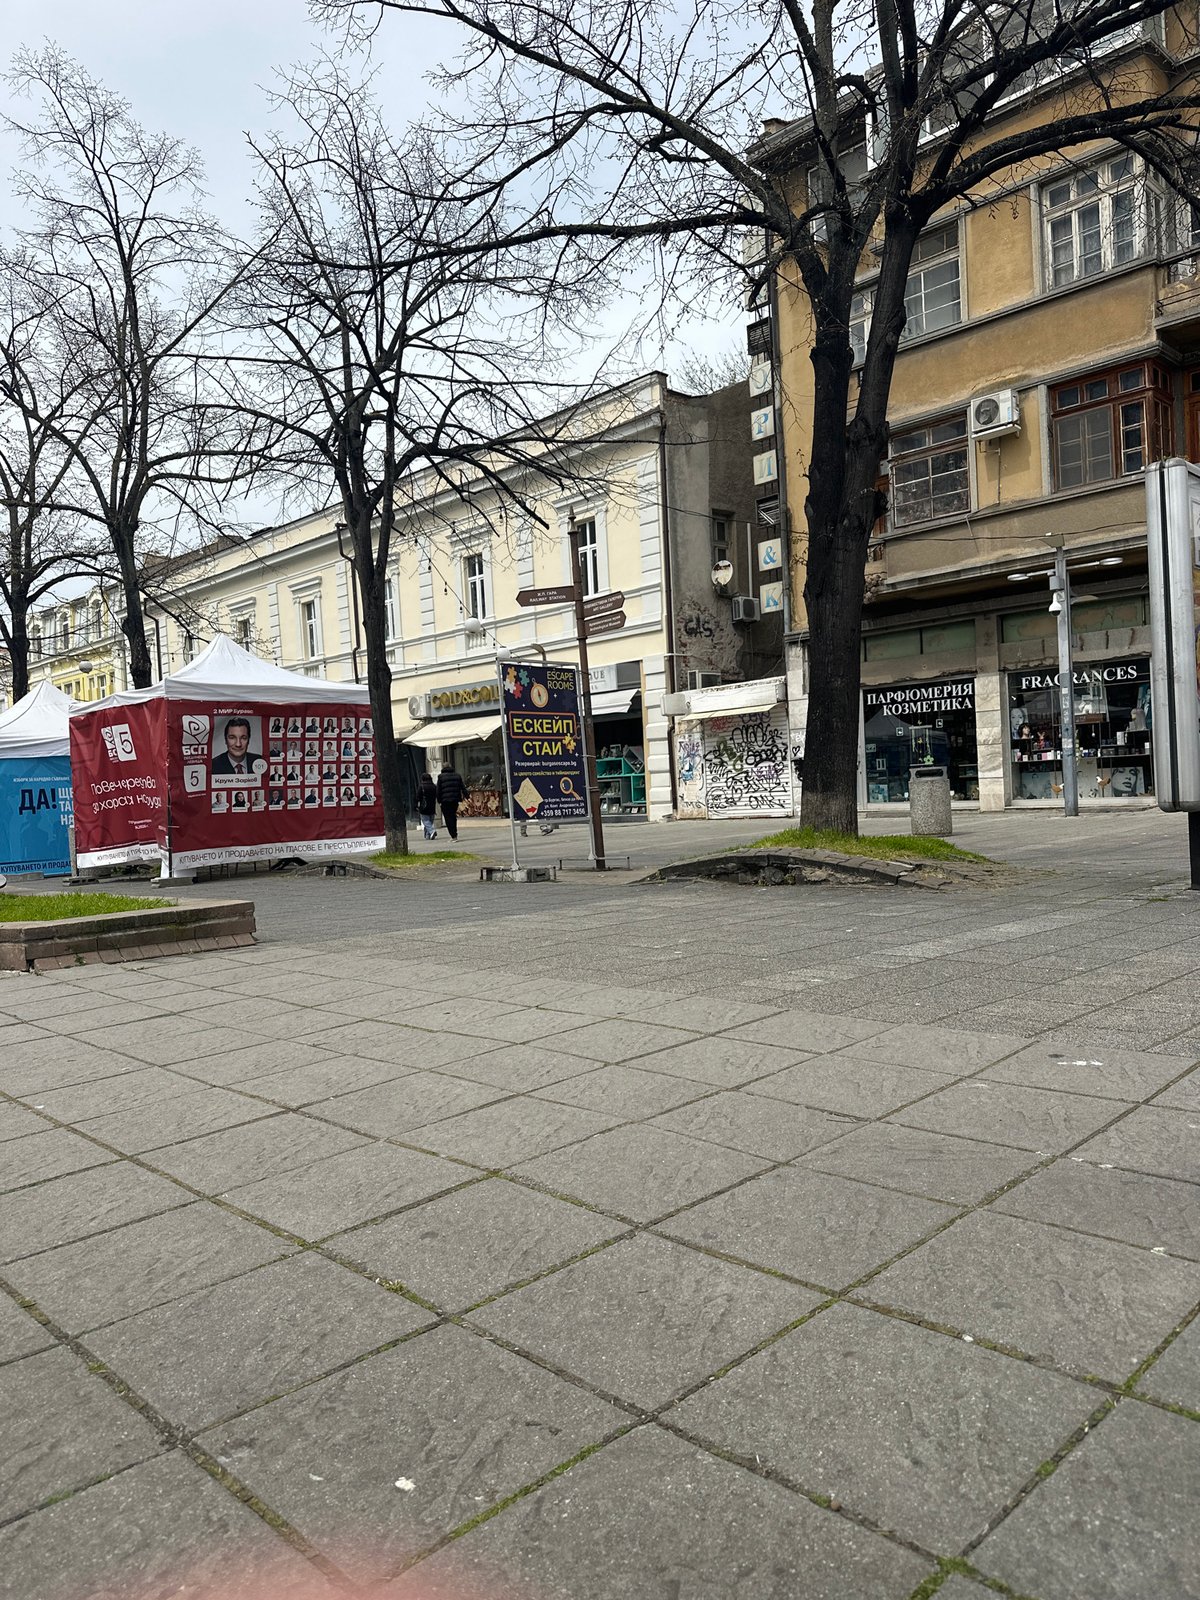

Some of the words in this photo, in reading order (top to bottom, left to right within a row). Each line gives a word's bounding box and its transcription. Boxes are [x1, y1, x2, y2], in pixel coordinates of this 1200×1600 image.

[547, 671, 574, 680] ESCAPE
[547, 681, 575, 691] ROOMS
[867, 683, 973, 705] ПАРФЮМЕРИЯ
[432, 685, 500, 708] GOLD&GOL
[883, 697, 973, 716] КОЗМЕТИКА
[513, 716, 573, 734] ЕСКЕЙП
[119, 732, 133, 754] 5
[182, 745, 208, 756] БСП
[523, 741, 562, 756] СТАИ
[108, 749, 119, 758] БС
[190, 770, 199, 787] 5
[18, 788, 57, 815] ДА!
[179, 852, 217, 864] КУПУВАНЕТО
[225, 848, 274, 858] ПРОДАВАНЕТО
[274, 846, 284, 854] НА
[286, 844, 316, 853] ГЛАСОВЕ
[0, 863, 41, 873] КУПУВАНЕТО
